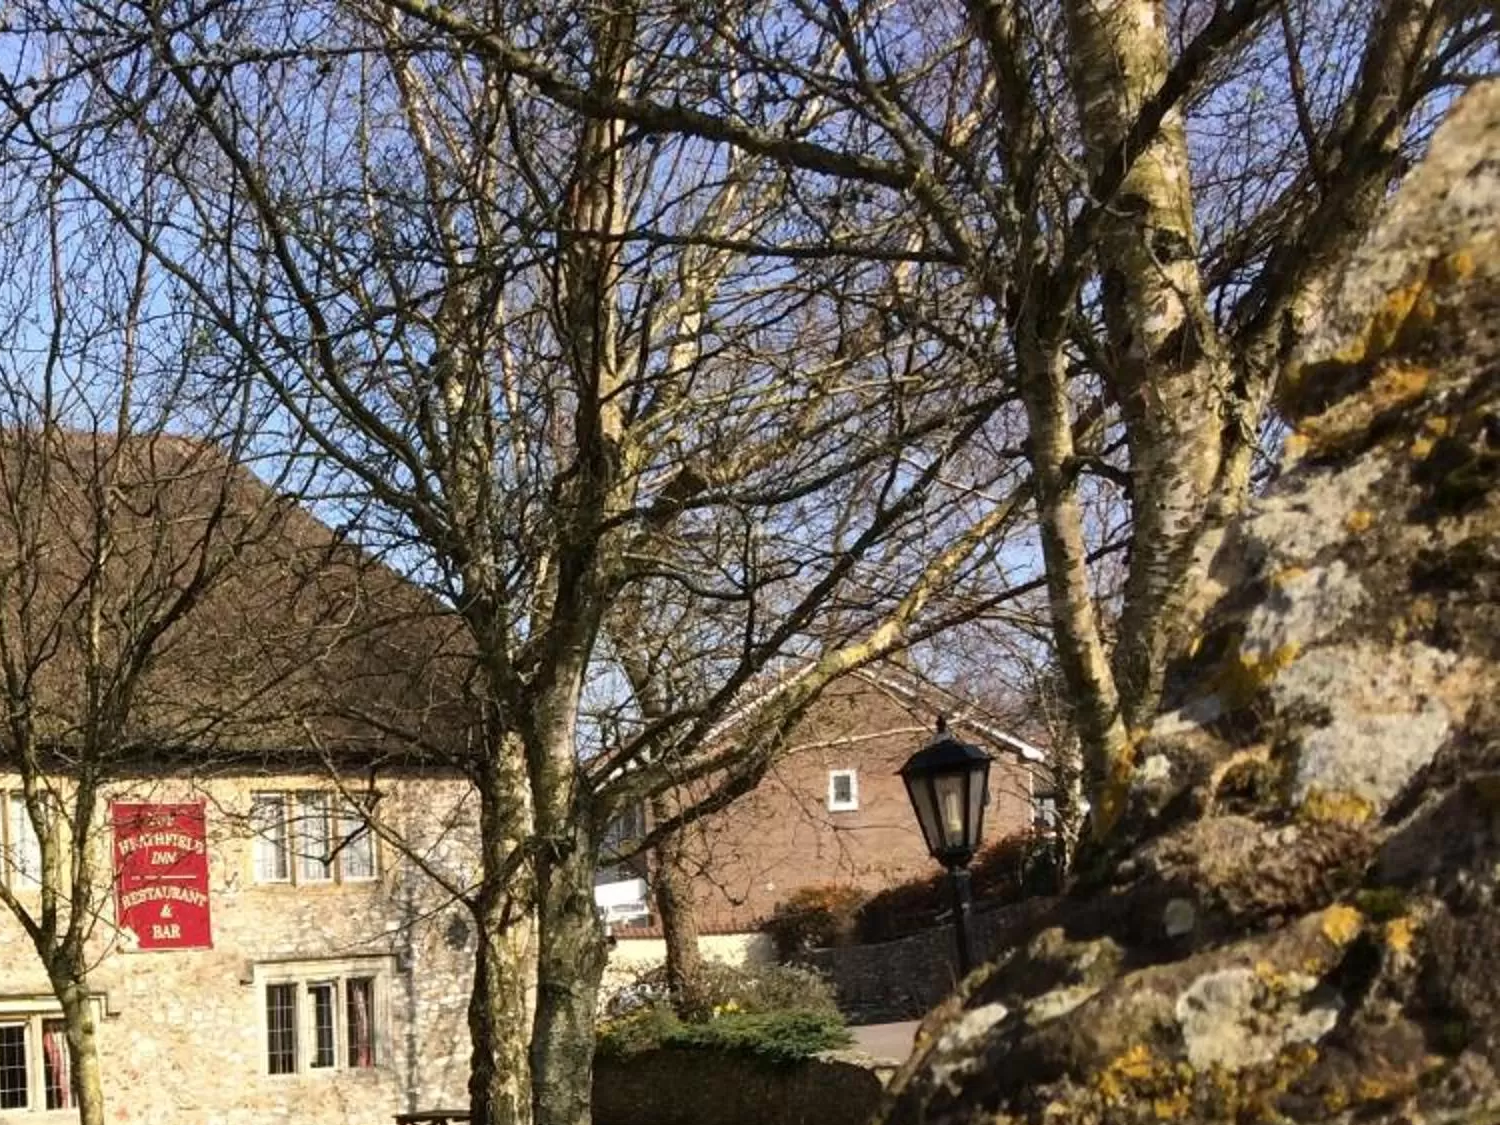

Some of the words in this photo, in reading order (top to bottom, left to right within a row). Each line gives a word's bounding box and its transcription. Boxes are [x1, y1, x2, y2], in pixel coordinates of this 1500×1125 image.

[151, 851, 177, 865] INN
[122, 886, 207, 909] RESTAURANT
[160, 905, 173, 918] &
[152, 924, 181, 940] BAR
